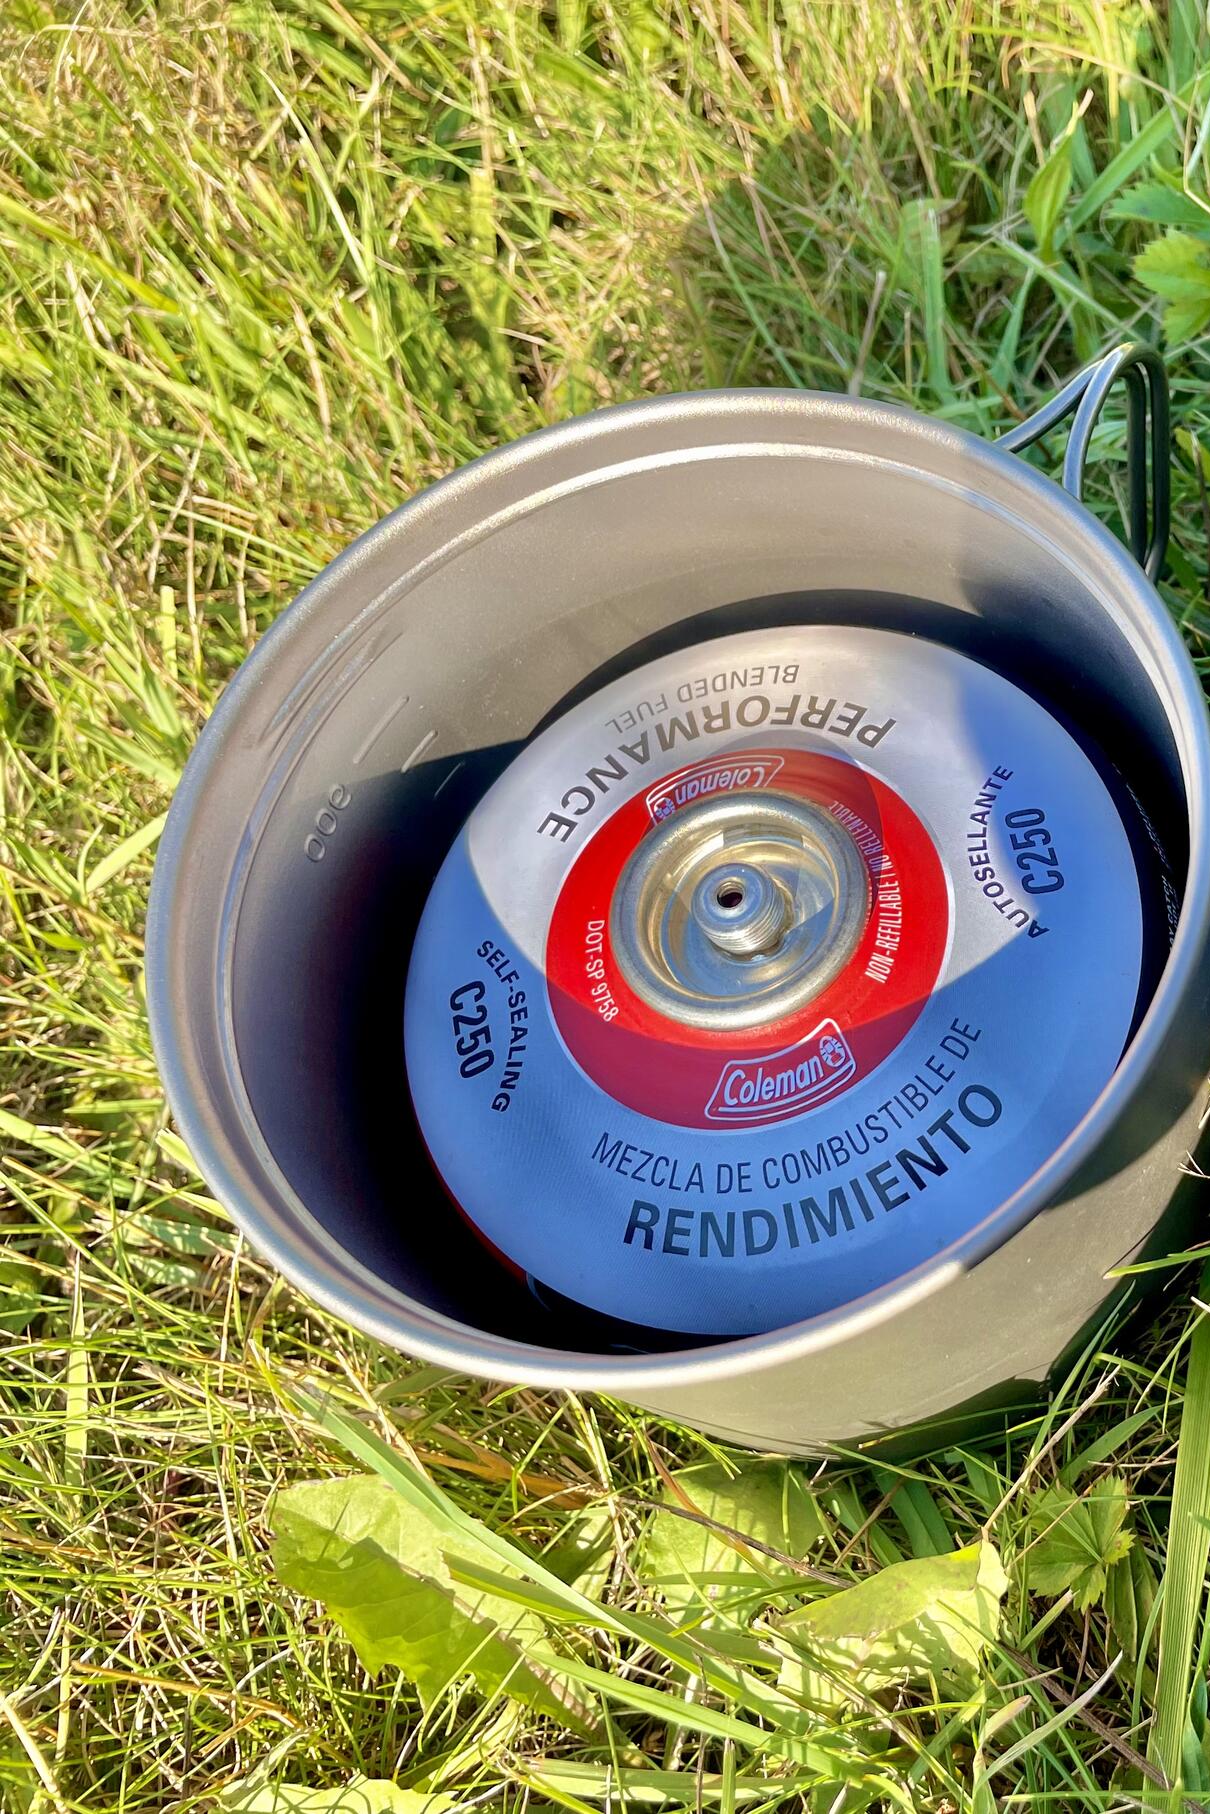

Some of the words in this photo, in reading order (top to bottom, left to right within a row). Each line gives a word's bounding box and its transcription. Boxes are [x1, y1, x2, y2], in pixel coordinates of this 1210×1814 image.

[604, 697, 669, 734] FUEL
[677, 664, 800, 703] BLENDED
[536, 694, 897, 843] PERFORMANCE
[673, 766, 766, 807] Coleman
[828, 800, 886, 857] RELLENABLE
[868, 854, 893, 873] NO
[966, 765, 1050, 939] AUTOSELLANTE
[1005, 808, 1065, 895] C250
[585, 919, 605, 980] DOT-SP
[864, 880, 903, 984] NON-REFILLABLE
[450, 980, 495, 1079] C250
[477, 940, 529, 1113] SELF-SEALING
[591, 982, 620, 1022] 9758
[592, 1132, 705, 1193] MEZCLA
[716, 1162, 753, 1194] DE
[762, 1055, 956, 1190] COMBUSTIBLE
[940, 1018, 982, 1061] DE
[724, 1055, 825, 1107] Coleman
[623, 1083, 1003, 1258] RENDIMIENTO
